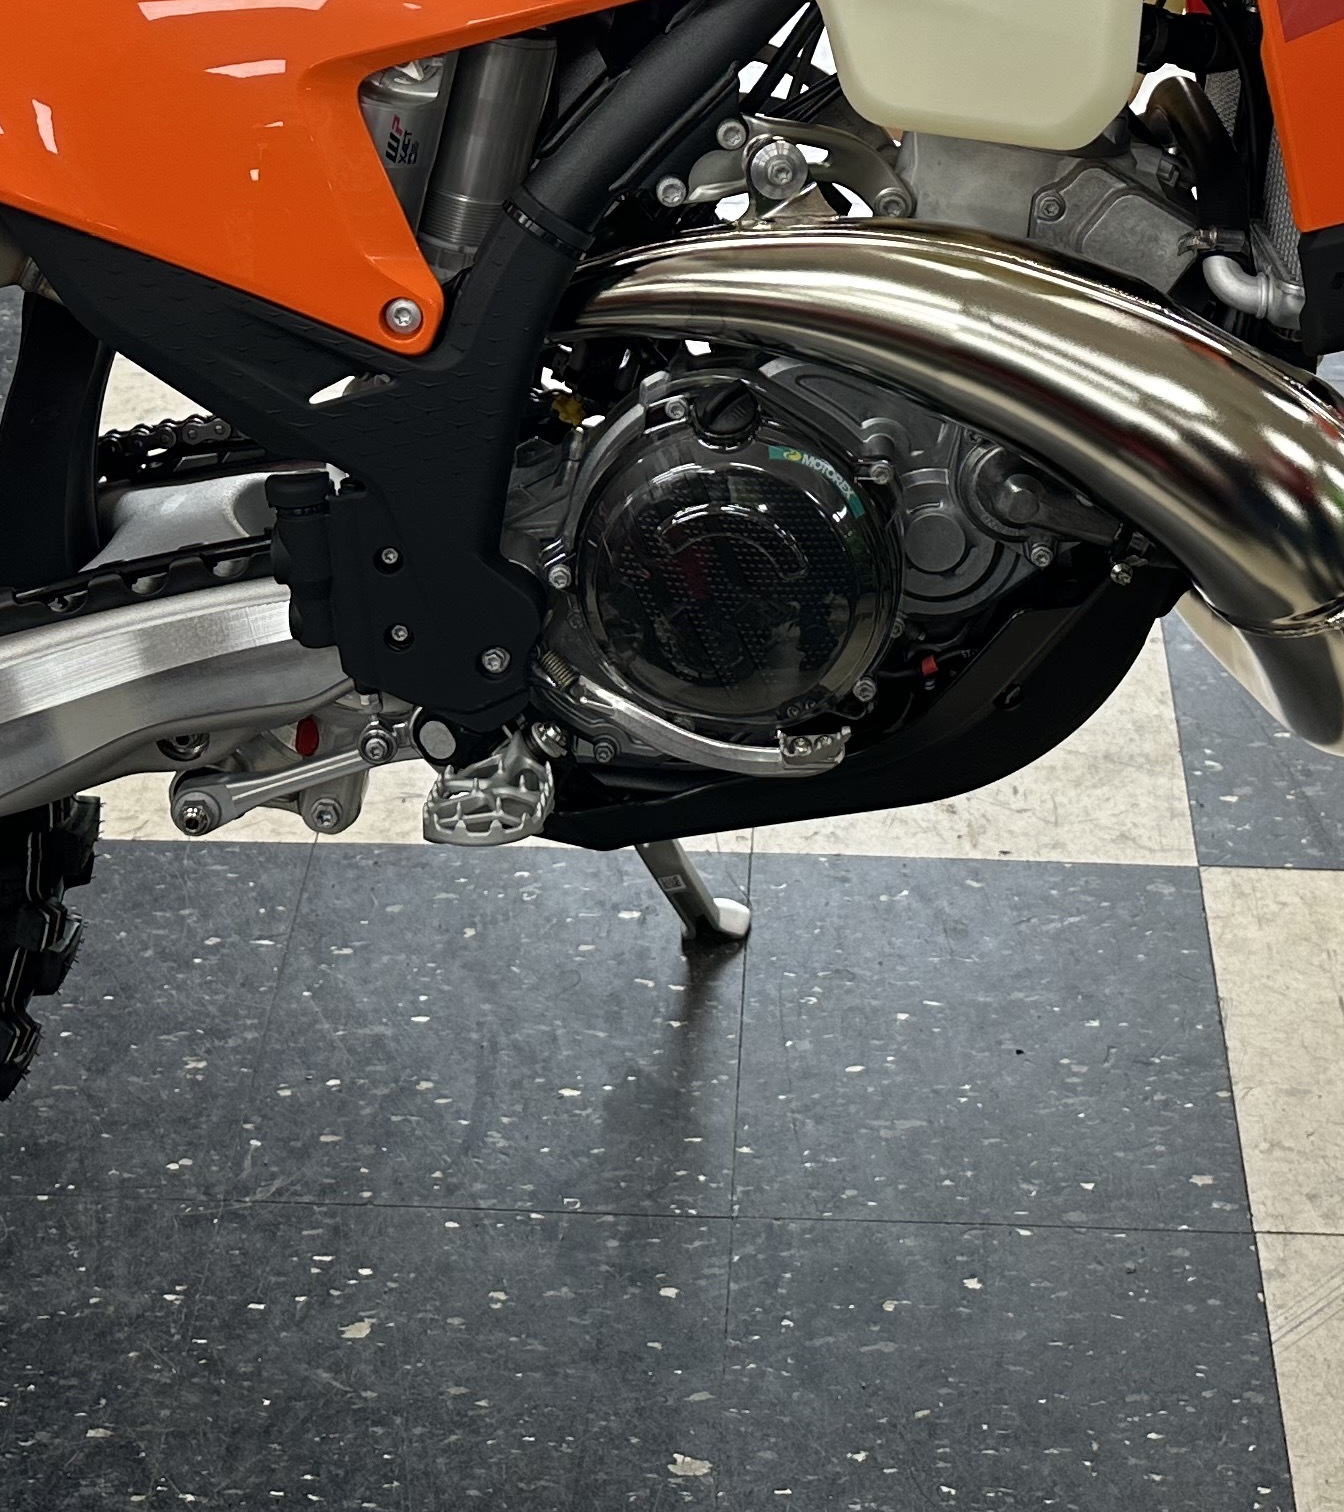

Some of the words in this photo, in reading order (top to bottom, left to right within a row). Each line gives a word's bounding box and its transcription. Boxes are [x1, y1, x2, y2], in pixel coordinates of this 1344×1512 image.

[385, 113, 403, 164] WP
[397, 129, 413, 165] XACT
[801, 452, 856, 502] MOTOREX
